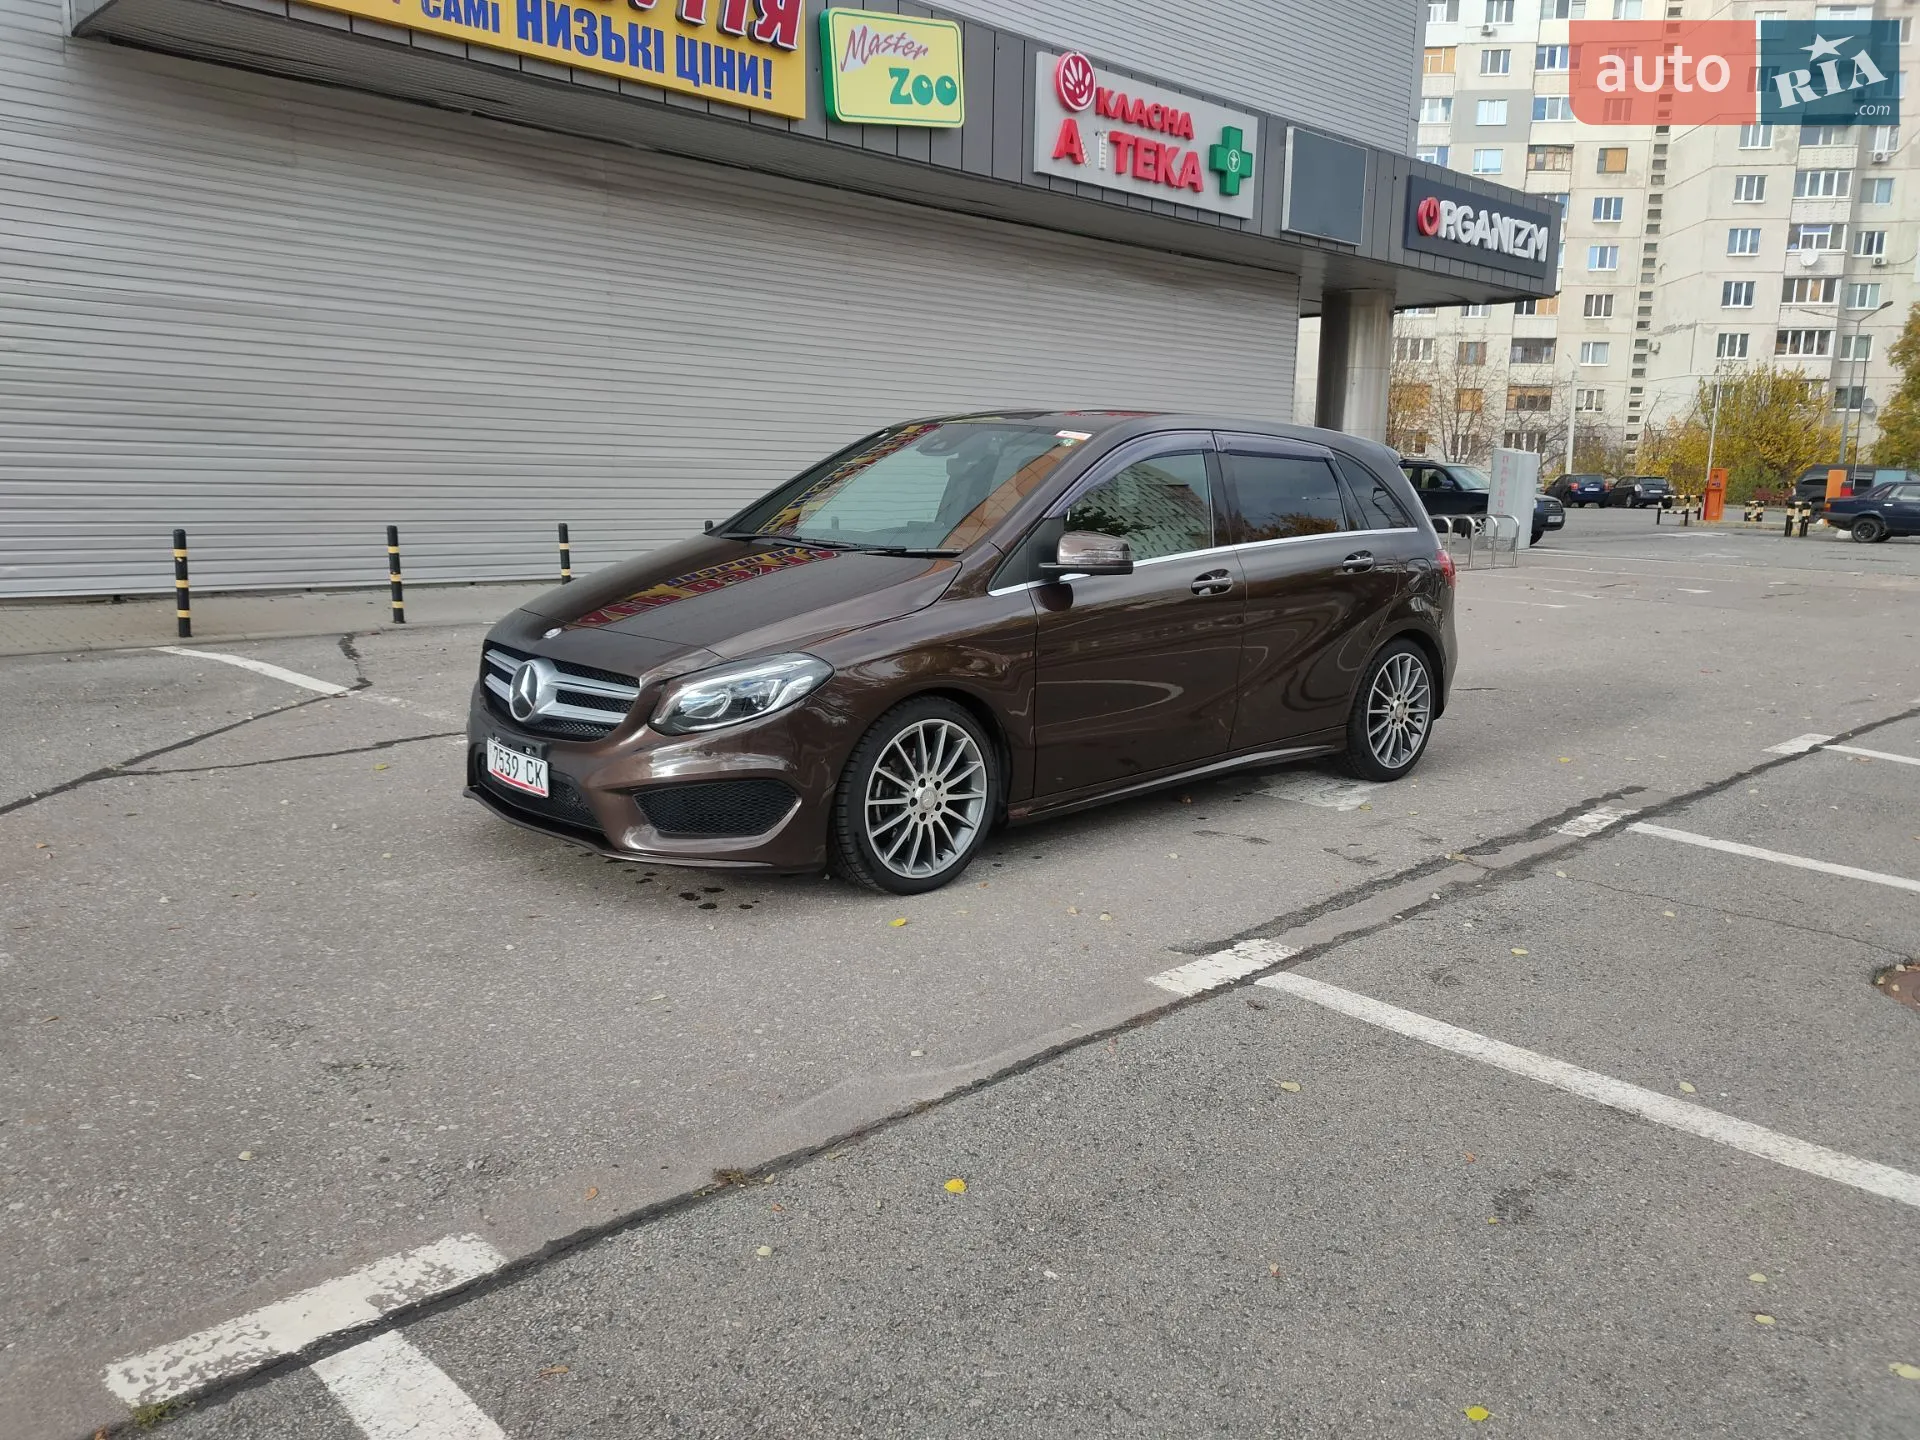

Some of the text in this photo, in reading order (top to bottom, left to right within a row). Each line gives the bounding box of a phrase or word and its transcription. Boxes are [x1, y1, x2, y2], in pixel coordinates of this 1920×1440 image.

[516, 0, 665, 74] НИЗЬКІ
[675, 34, 773, 100] ЦІНИ!
[840, 25, 928, 72] Master
[1095, 87, 1194, 140] КЛАСНА
[1417, 196, 1549, 263] ORGANIZM
[493, 745, 543, 788] 7539 CK
